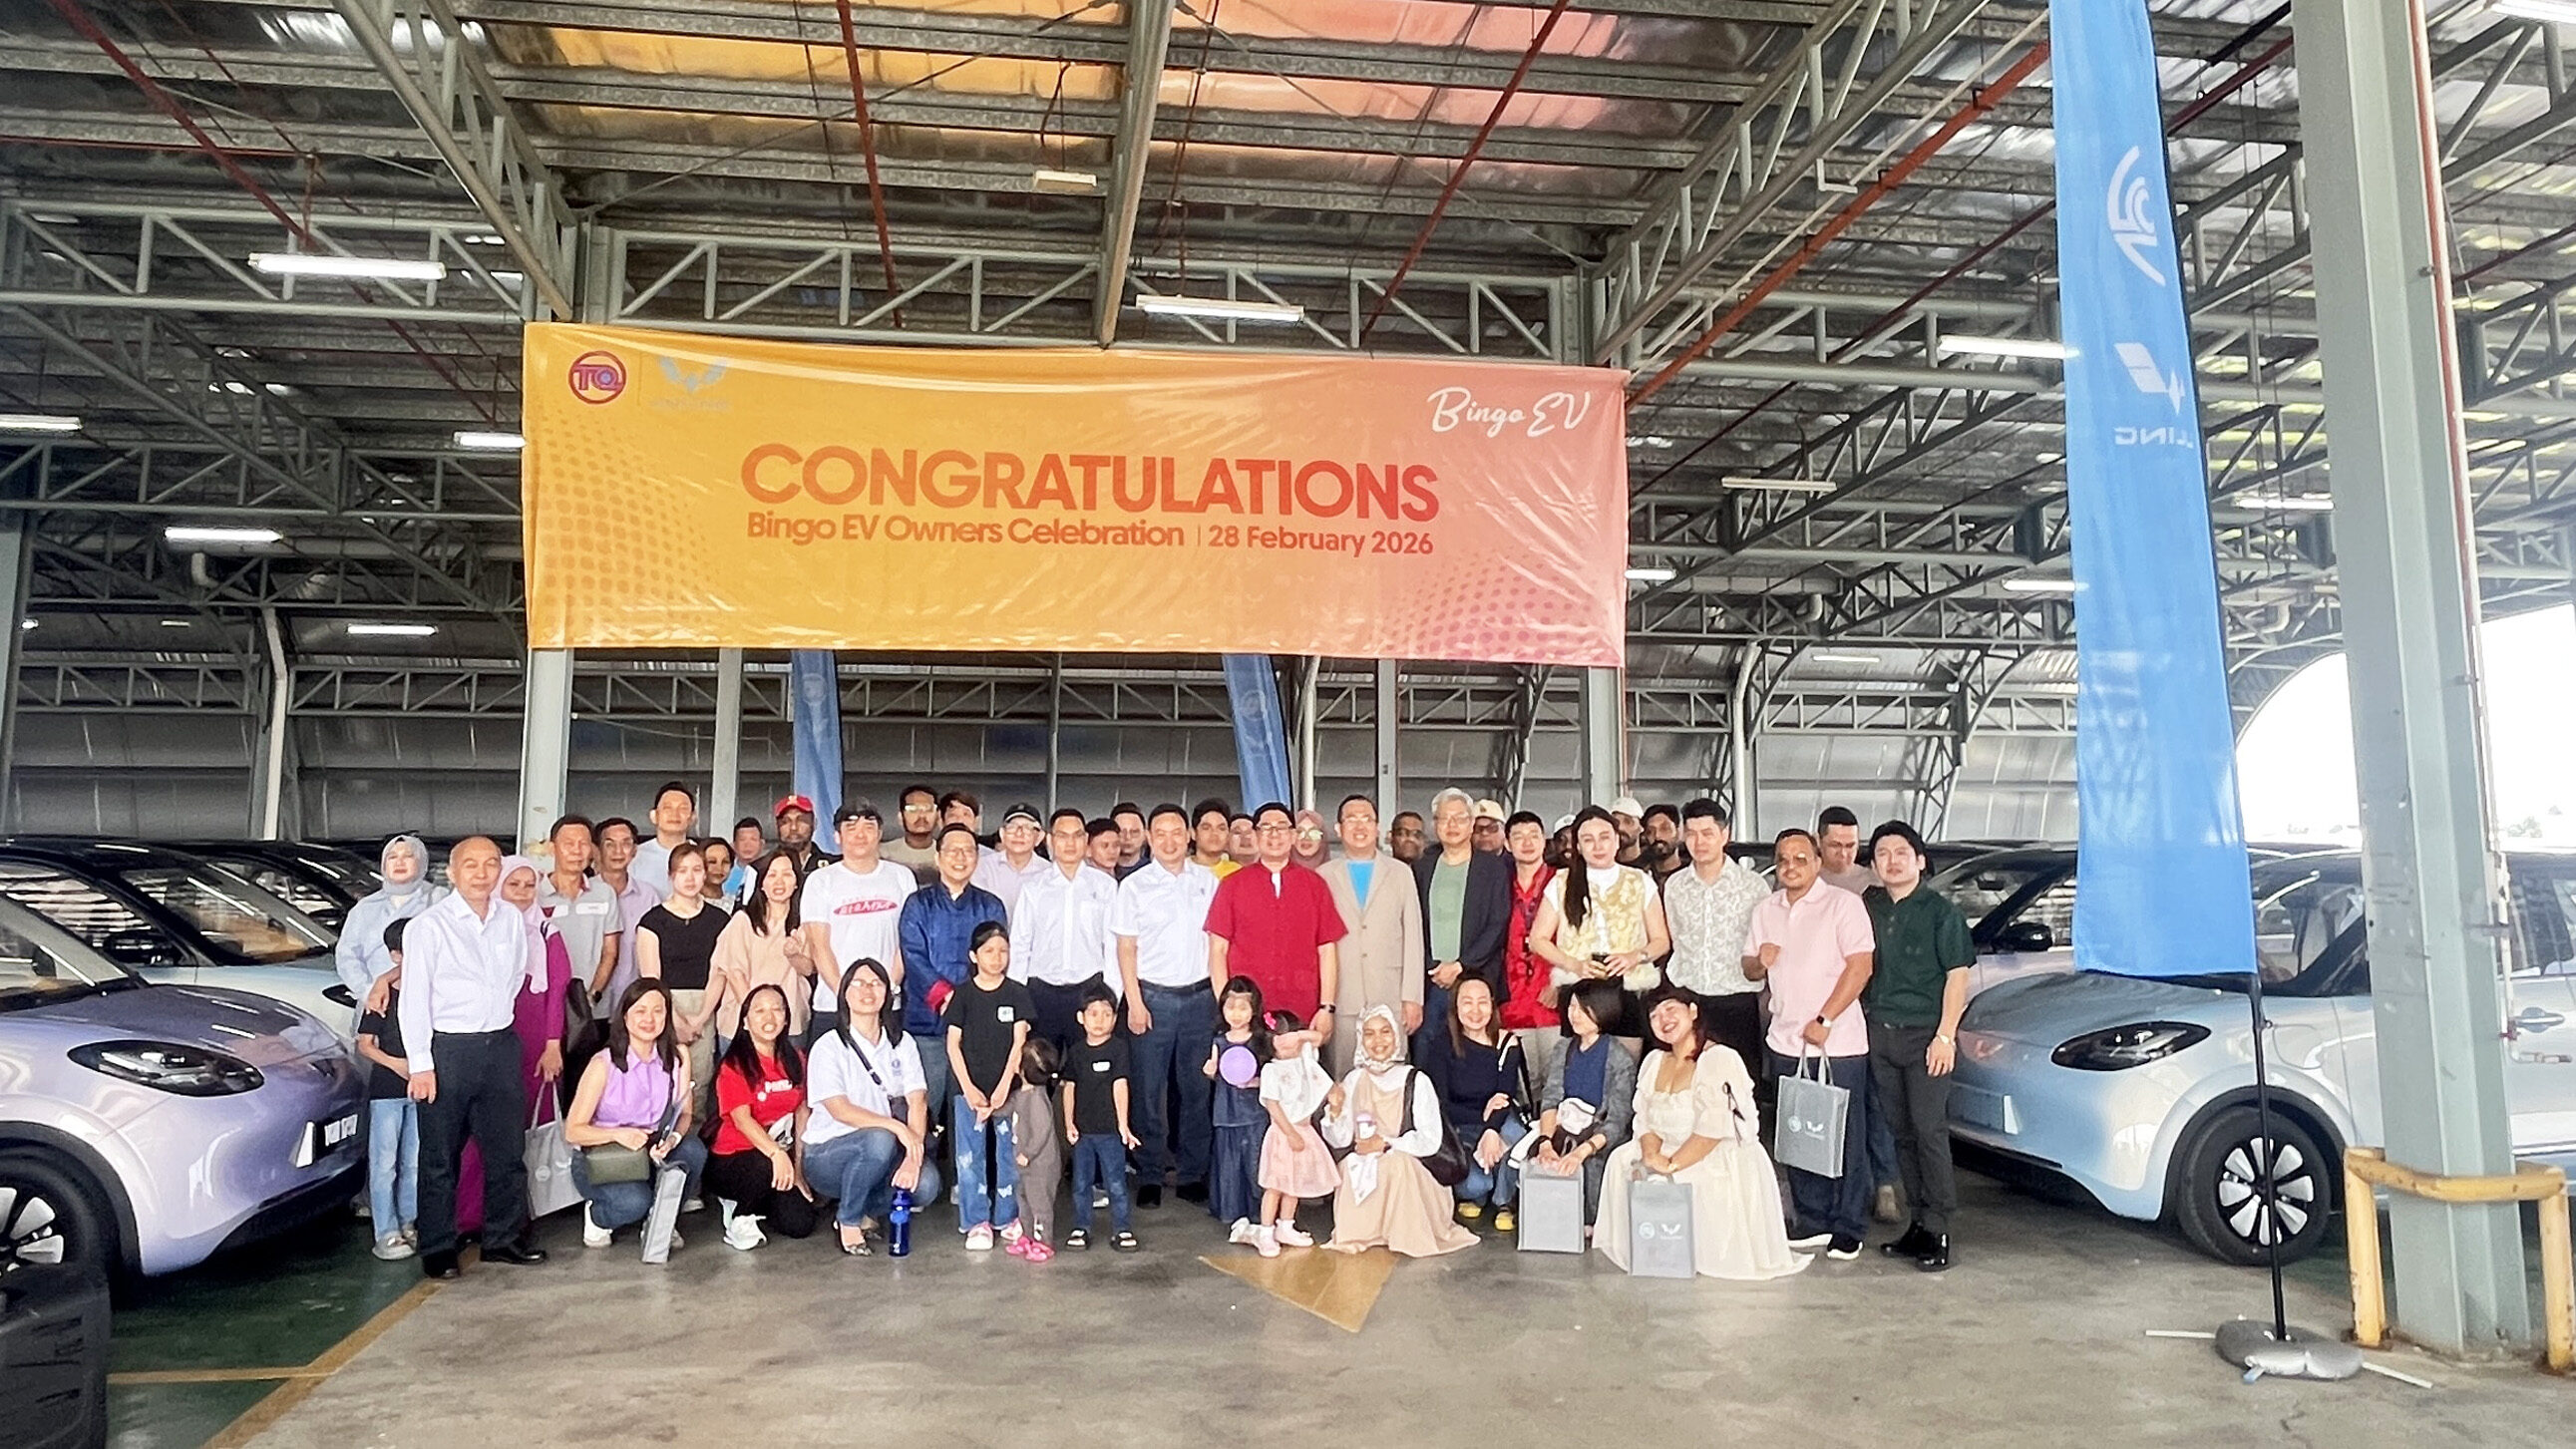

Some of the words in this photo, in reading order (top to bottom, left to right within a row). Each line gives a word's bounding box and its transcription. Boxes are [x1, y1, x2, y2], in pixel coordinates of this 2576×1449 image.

[1427, 386, 1526, 439] Bingo
[1527, 391, 1592, 438] EV
[741, 444, 1439, 523] CONGRATULATIONS
[747, 511, 837, 545] Bingo
[843, 514, 881, 541] EV
[885, 515, 1002, 543] Owners
[1007, 518, 1185, 546] Celebration
[1208, 525, 1240, 547] 28
[1247, 526, 1365, 558] February
[1371, 531, 1434, 554] 2026
